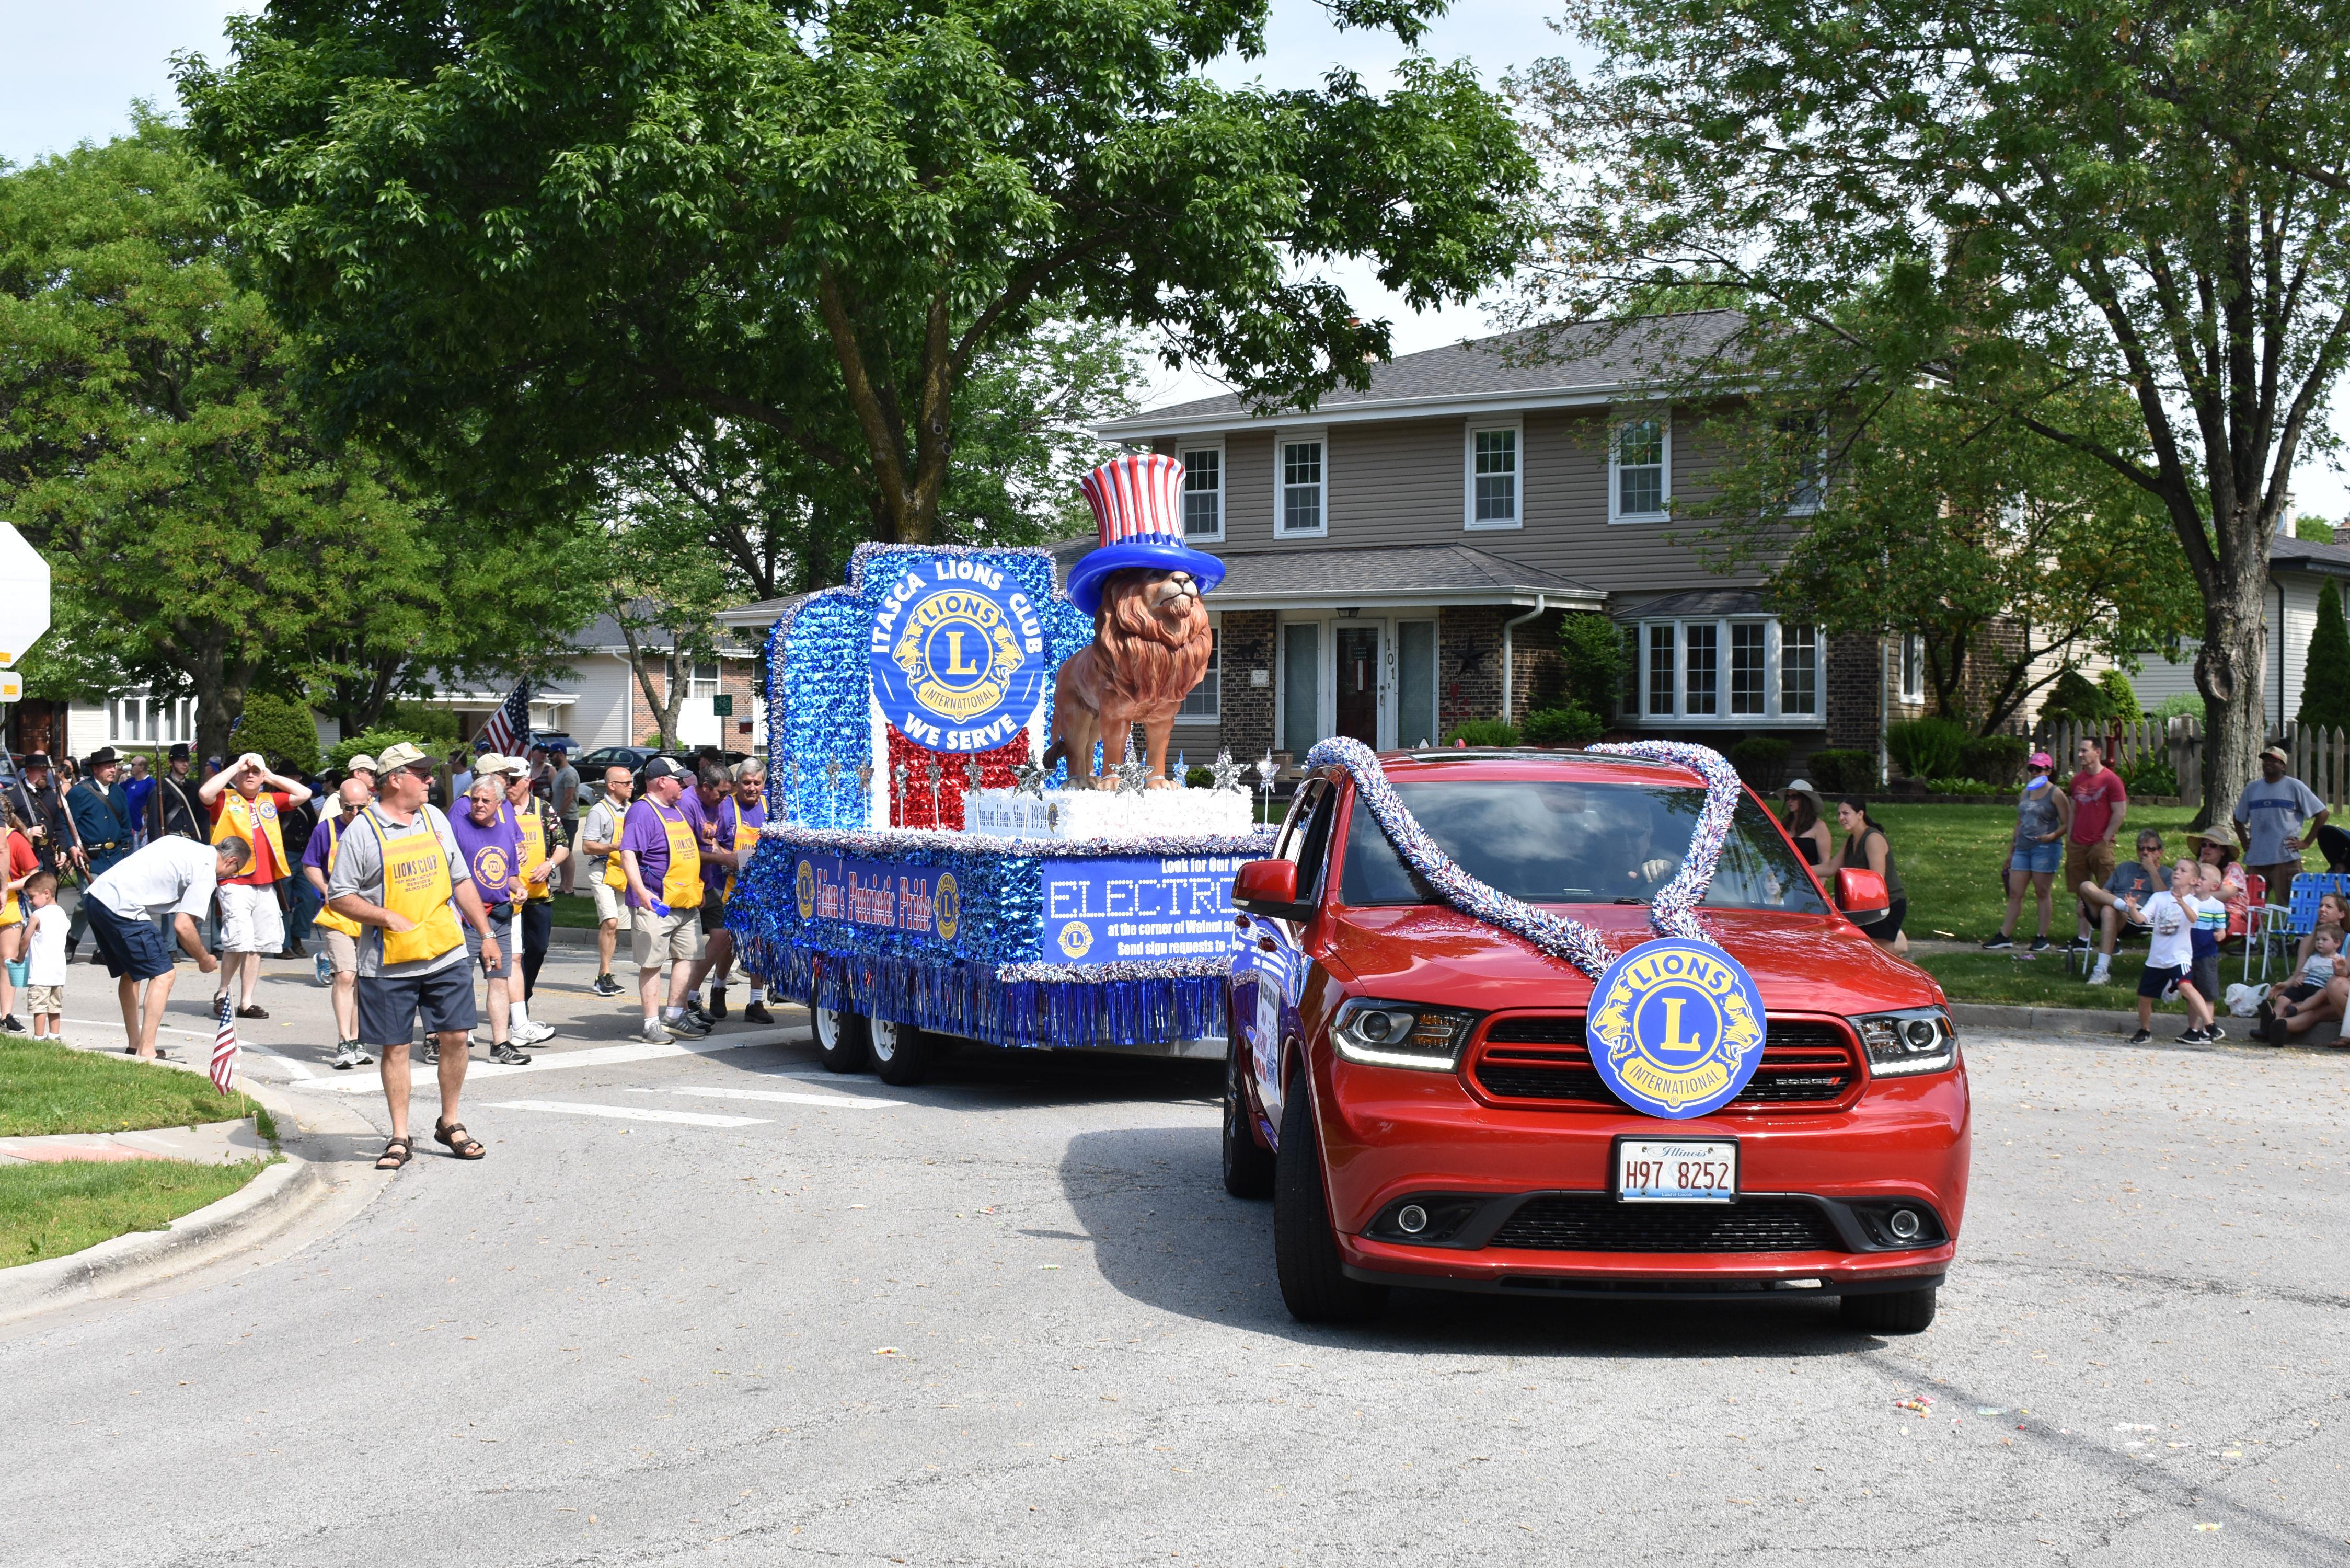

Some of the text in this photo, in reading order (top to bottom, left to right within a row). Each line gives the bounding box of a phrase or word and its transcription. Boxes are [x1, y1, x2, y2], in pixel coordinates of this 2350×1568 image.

[871, 560, 1043, 654] ITASCA LIONS CLUB
[922, 596, 995, 624] LIONS
[946, 631, 977, 675] L
[1387, 638, 1395, 680] 101
[924, 687, 995, 710] INTERNATIONAL
[904, 711, 1017, 750] WE SERVE
[978, 803, 994, 827] tasca
[996, 803, 1011, 827] Lions
[1031, 805, 1047, 829] 1939
[393, 855, 437, 879] LIONS CLUB
[1161, 858, 1190, 874] Look
[1191, 858, 1206, 873] for
[1209, 857, 1229, 873] Our
[407, 879, 431, 887] SERVICES
[817, 859, 932, 932] Lion's Patriotic Pride
[940, 877, 955, 890] LIONS
[944, 895, 951, 917] L
[1072, 933, 1081, 946] L
[1108, 923, 1119, 937] at
[1120, 923, 1143, 936] the
[1144, 923, 1172, 936] corner
[1174, 920, 1184, 935] of
[1186, 919, 1228, 934] Walnut
[1117, 942, 1144, 956] Send
[1145, 942, 1168, 958] sign
[1169, 940, 1212, 955] requests
[1213, 940, 1226, 952] to
[1631, 954, 1728, 988] LIONS
[1660, 998, 1701, 1052] L
[1629, 1064, 1722, 1094] INTERNATIONAL
[1647, 1146, 1708, 1157] Illinois
[1626, 1161, 1729, 1190] H97 8252
